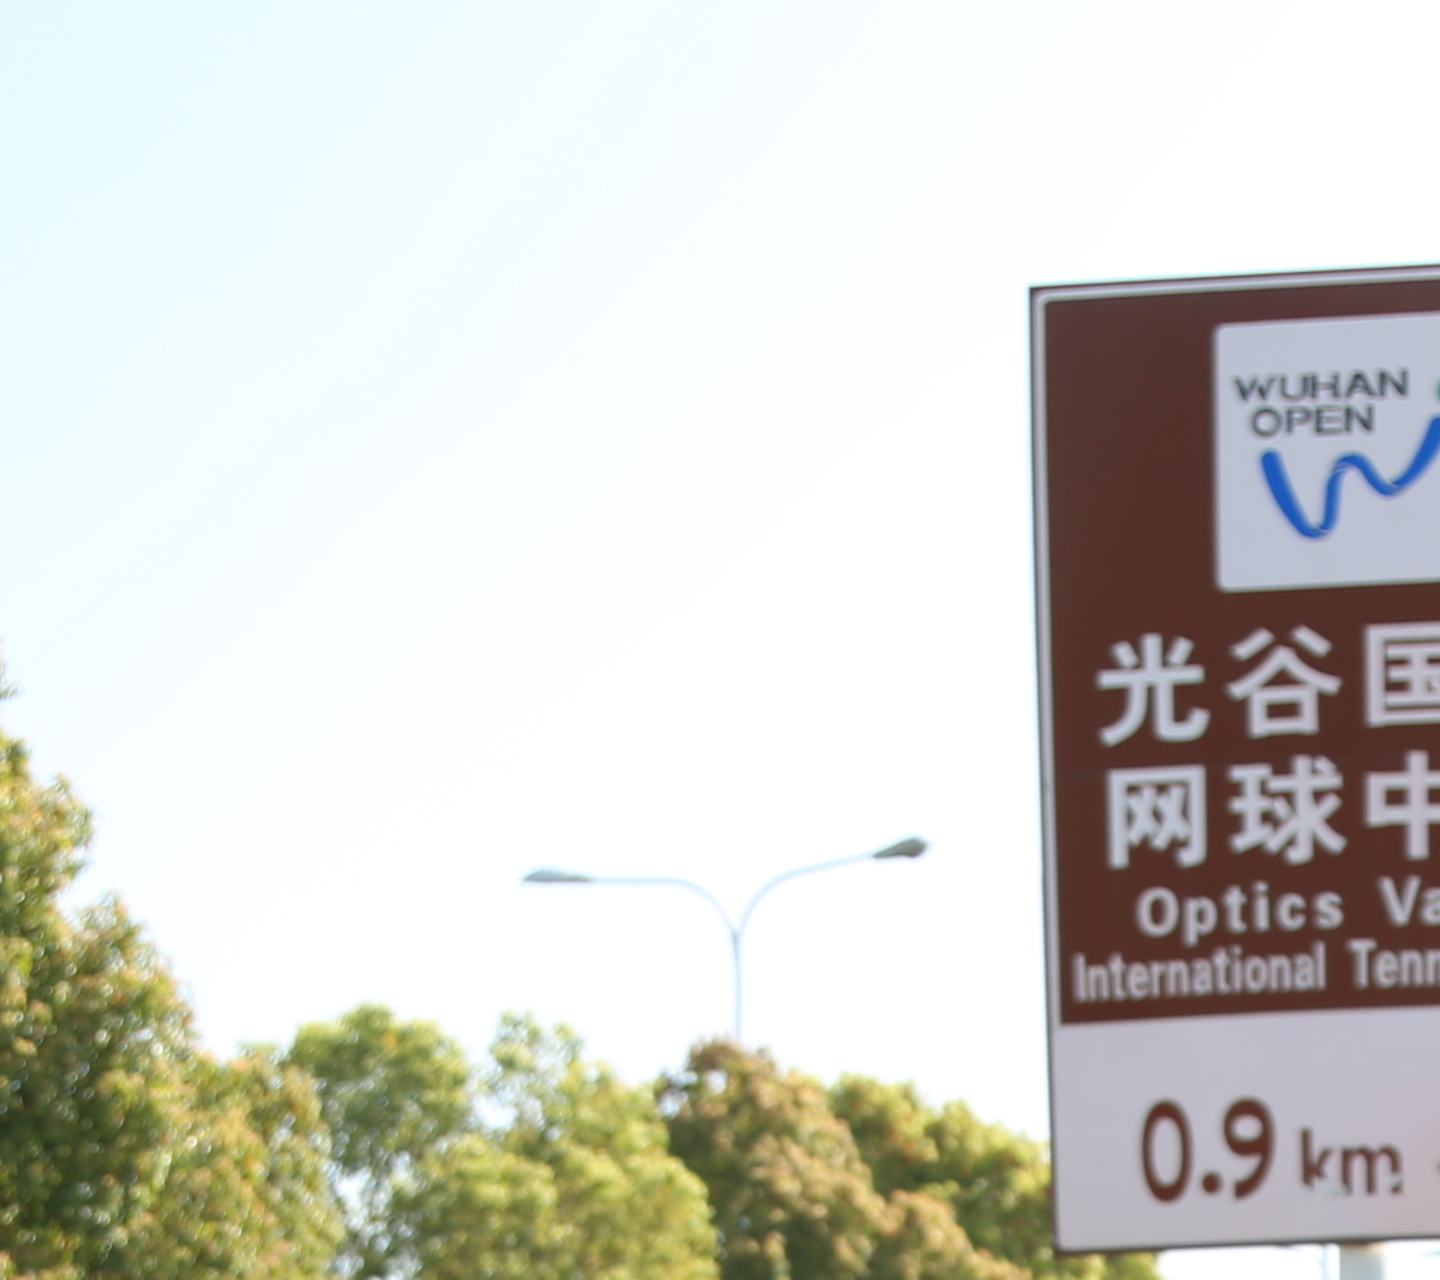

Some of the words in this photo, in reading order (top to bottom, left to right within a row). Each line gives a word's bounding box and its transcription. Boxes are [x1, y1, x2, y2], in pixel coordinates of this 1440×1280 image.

[1234, 367, 1409, 401] WUHAN
[1251, 403, 1374, 437] OPEN
[1136, 881, 1344, 946] Optics
[1073, 943, 1327, 1001] International
[1140, 1097, 1275, 1203] 0.9
[1299, 1127, 1403, 1197] km
